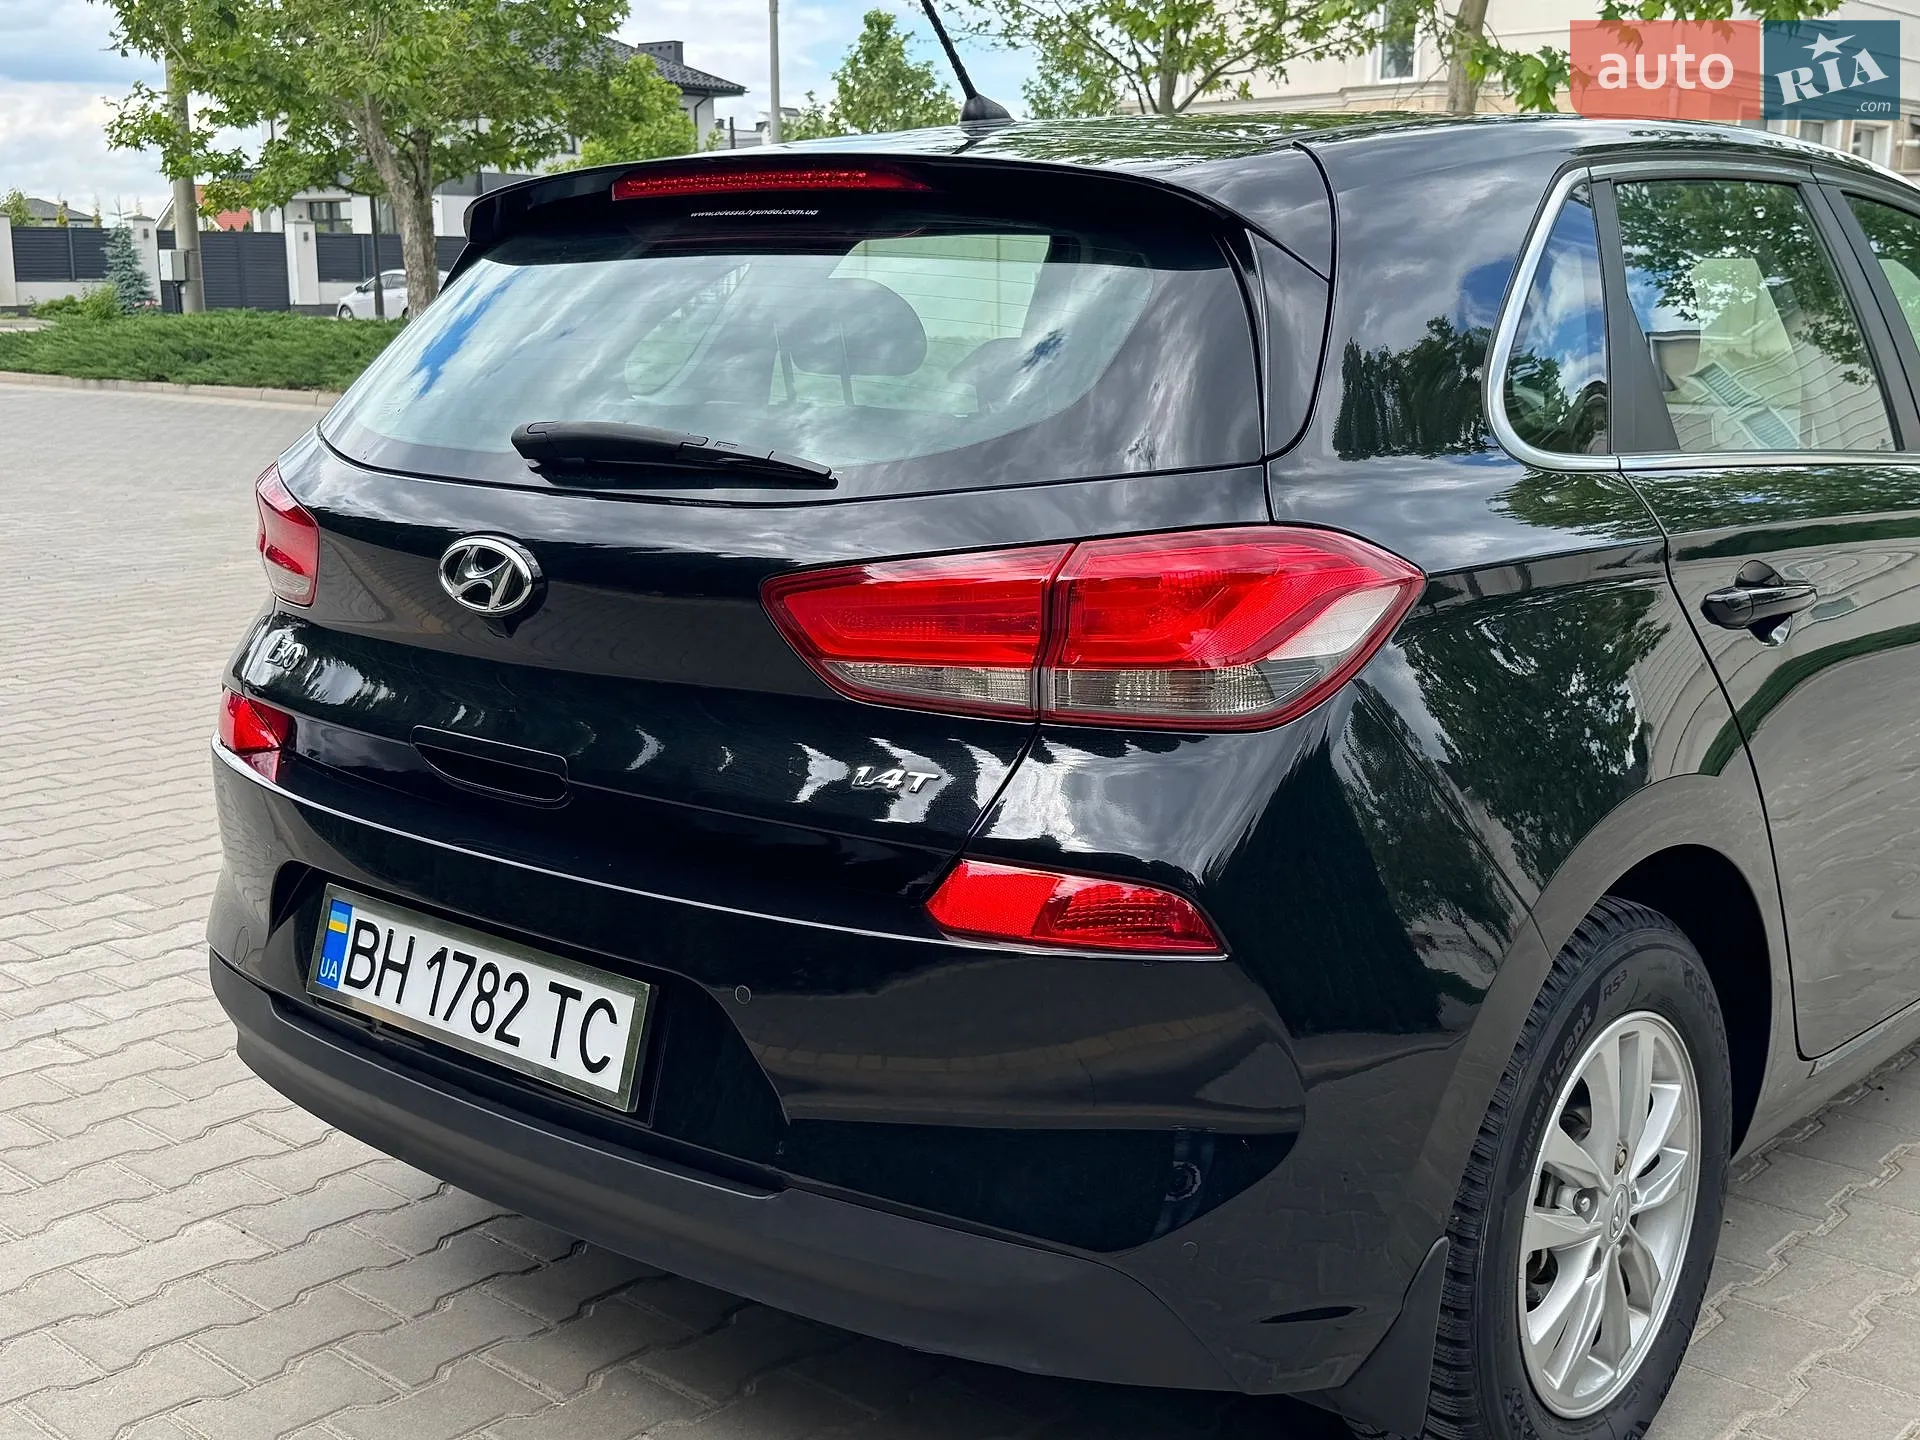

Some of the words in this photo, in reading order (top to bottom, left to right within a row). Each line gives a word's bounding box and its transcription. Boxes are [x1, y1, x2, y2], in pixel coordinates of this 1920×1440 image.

[319, 955, 339, 982] UA
[343, 918, 416, 1005] BH
[426, 946, 530, 1048] 1782
[548, 981, 618, 1074] TC
